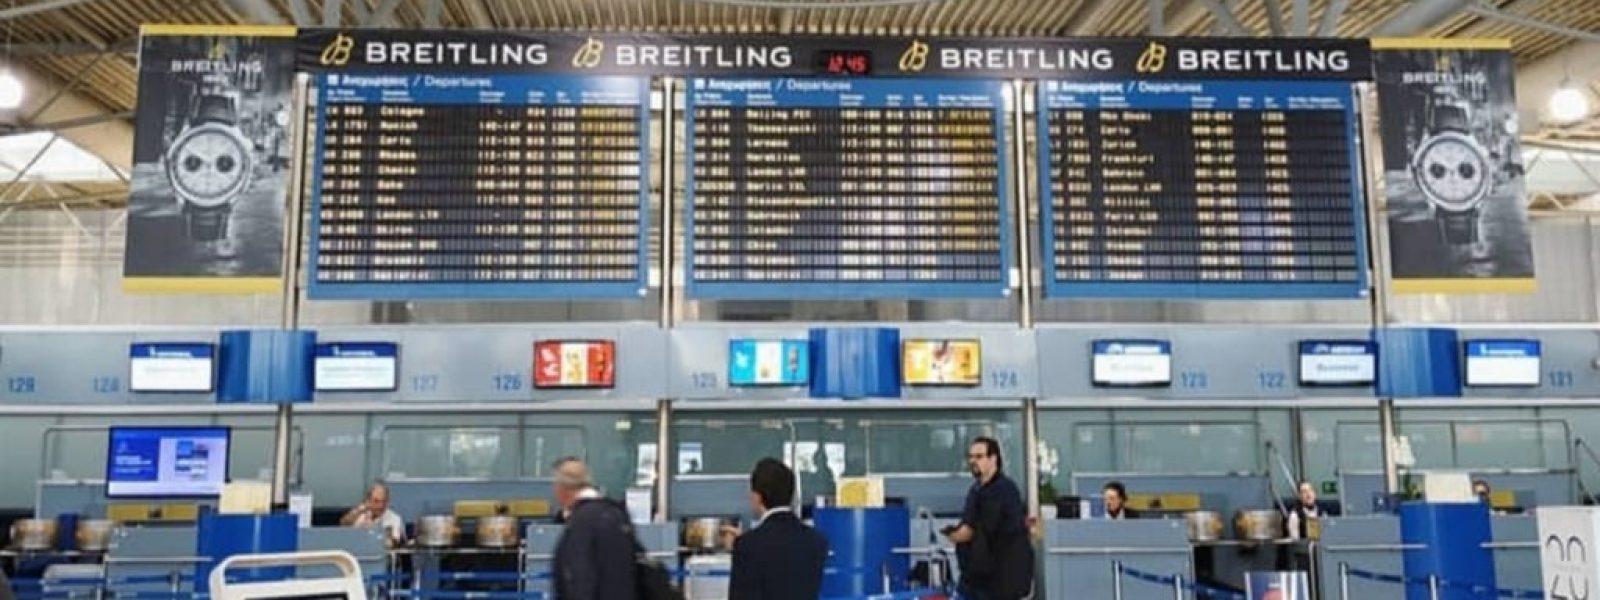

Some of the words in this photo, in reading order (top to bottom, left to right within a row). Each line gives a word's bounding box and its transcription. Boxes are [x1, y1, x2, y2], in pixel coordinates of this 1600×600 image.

[366, 43, 548, 65] BREITLING
[616, 45, 792, 68] BREITLING
[940, 48, 1114, 70] BREITLING
[1178, 50, 1349, 71] BREITLING
[171, 60, 262, 73] BREITLING
[424, 75, 492, 88] Departures
[787, 78, 850, 92] Departures
[1402, 72, 1486, 84] BREITLING
[1138, 81, 1203, 94] Departures
